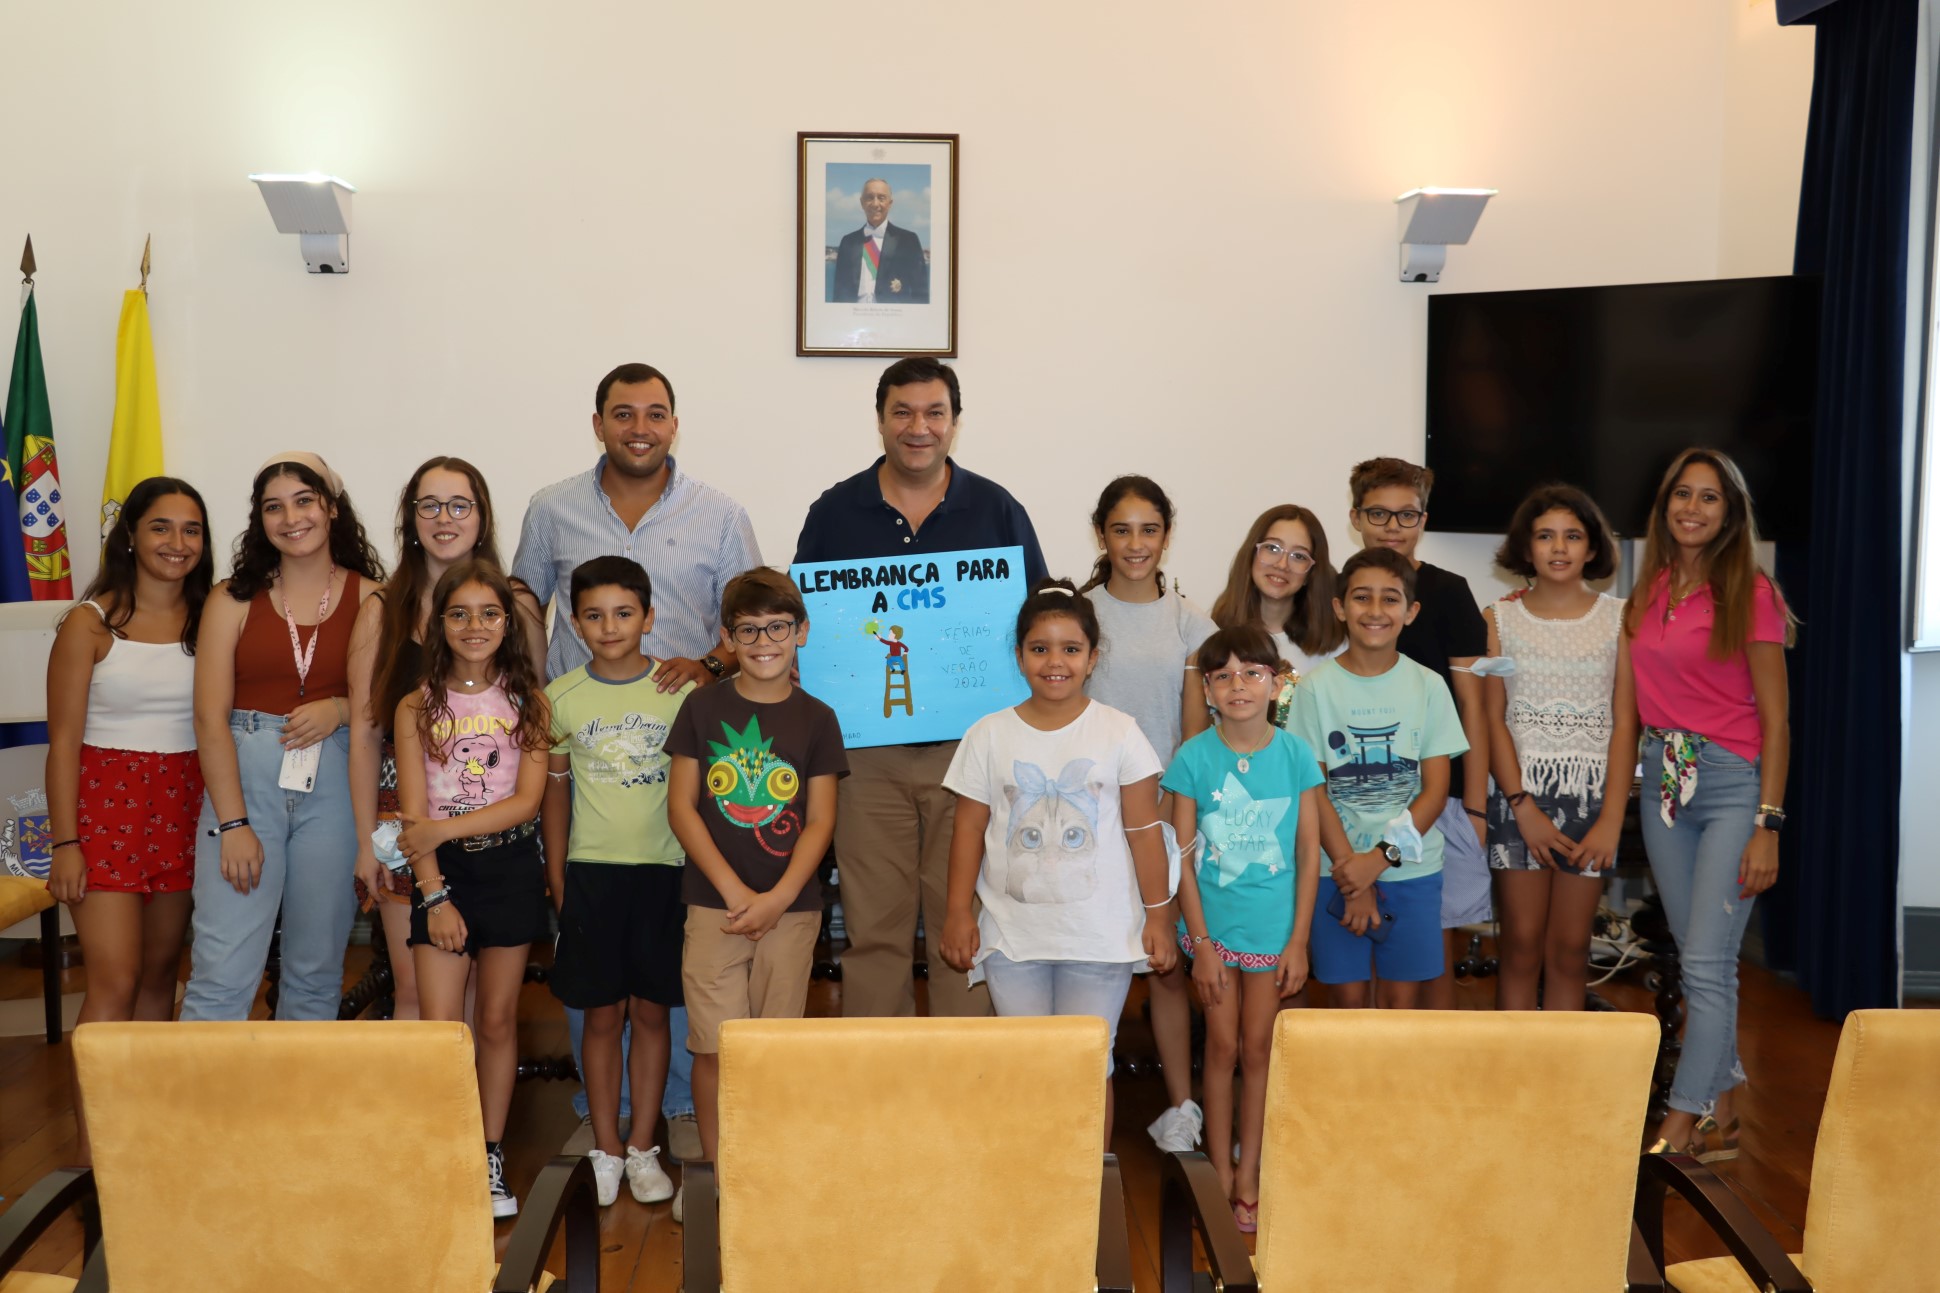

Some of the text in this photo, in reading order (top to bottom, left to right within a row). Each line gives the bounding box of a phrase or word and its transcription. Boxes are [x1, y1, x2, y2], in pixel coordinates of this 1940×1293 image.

[799, 558, 1010, 593] LEMBRANÇA PARA
[871, 586, 946, 613] A CMS
[959, 645, 975, 656] DE
[940, 657, 988, 674] VERÃO
[953, 675, 987, 689] 2022
[432, 714, 514, 740] SNOOPY
[1225, 809, 1273, 828] LUCKY
[1228, 833, 1267, 851] STAR
